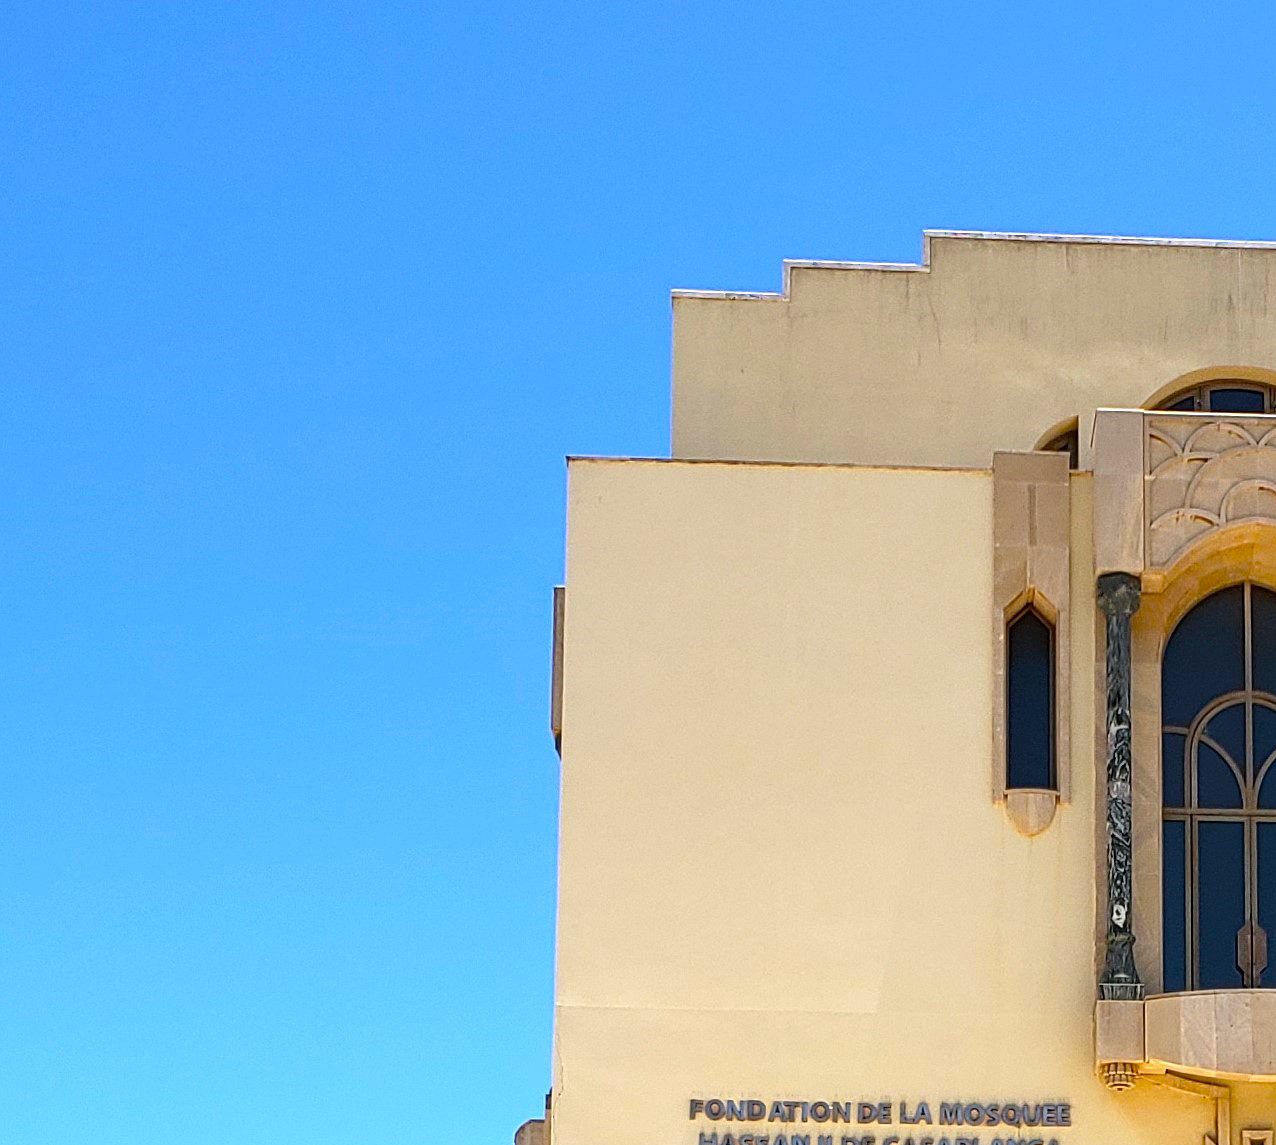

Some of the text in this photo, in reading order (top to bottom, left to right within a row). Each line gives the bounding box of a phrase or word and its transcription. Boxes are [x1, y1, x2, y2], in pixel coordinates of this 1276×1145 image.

[689, 1099, 1072, 1127] FONDATION DE LA MOSQUEE
